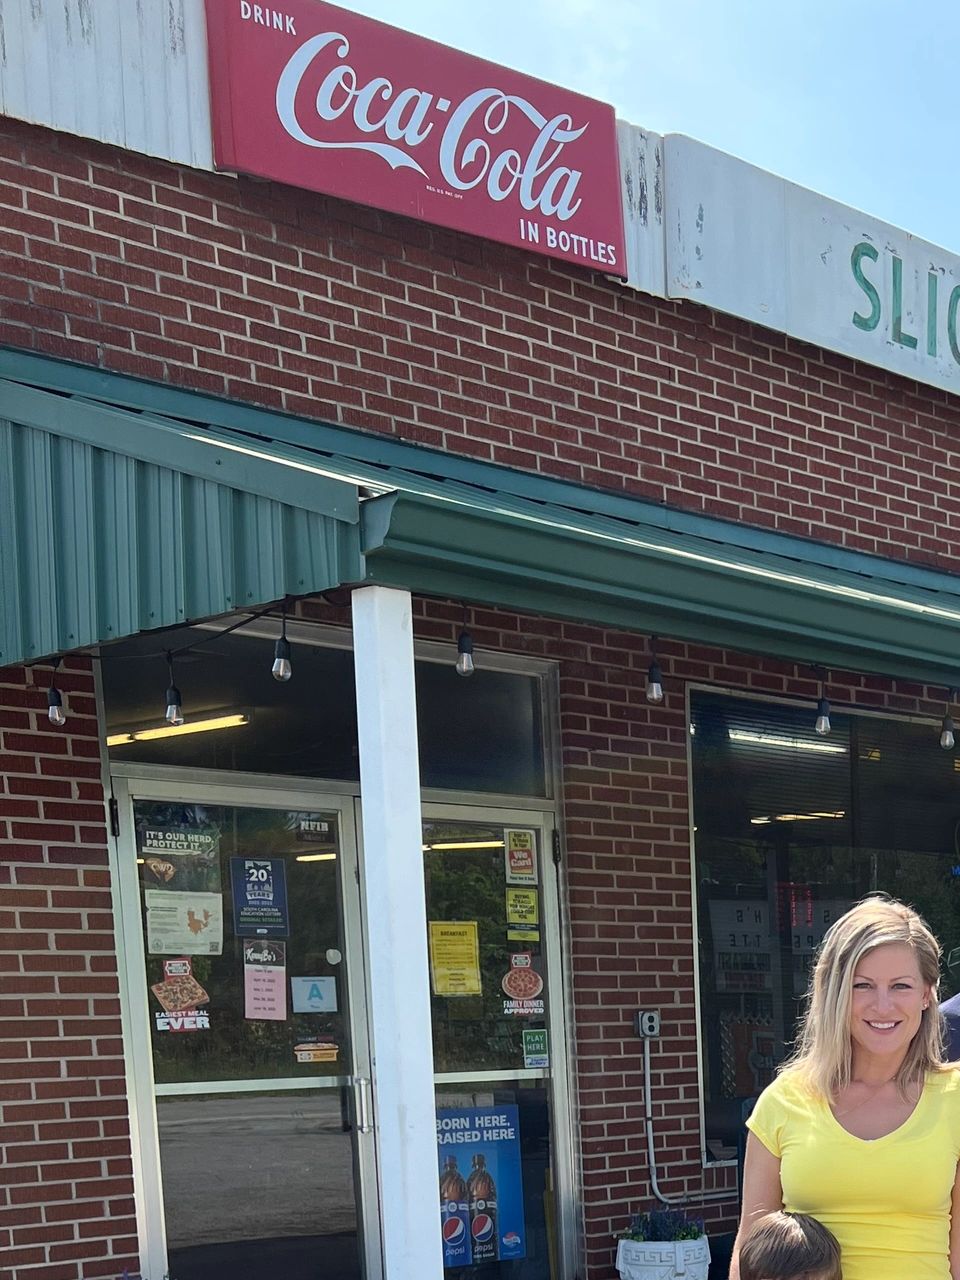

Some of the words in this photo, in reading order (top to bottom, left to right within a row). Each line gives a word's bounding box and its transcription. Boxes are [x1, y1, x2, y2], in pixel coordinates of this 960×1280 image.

[240, 1, 297, 36] DRINK
[276, 31, 590, 221] Coca-Cola
[520, 219, 539, 244] IN
[547, 225, 616, 266] BOTTLES
[146, 831, 163, 840] IT'S
[166, 833, 185, 841] OUR
[188, 834, 215, 843] HERD.
[147, 840, 188, 849] PROTECT
[249, 869, 268, 882] 20
[307, 984, 324, 1001] A
[504, 1000, 524, 1008] FAMILY
[524, 1000, 544, 1008] DINNER
[157, 1017, 210, 1031] EVER
[528, 1043, 545, 1051] HERE
[436, 1117, 470, 1131] BORN
[437, 1131, 481, 1145] RAISED
[484, 1128, 516, 1141] HERE
[446, 1246, 465, 1256] pepsi
[474, 1244, 493, 1254] pepsi
